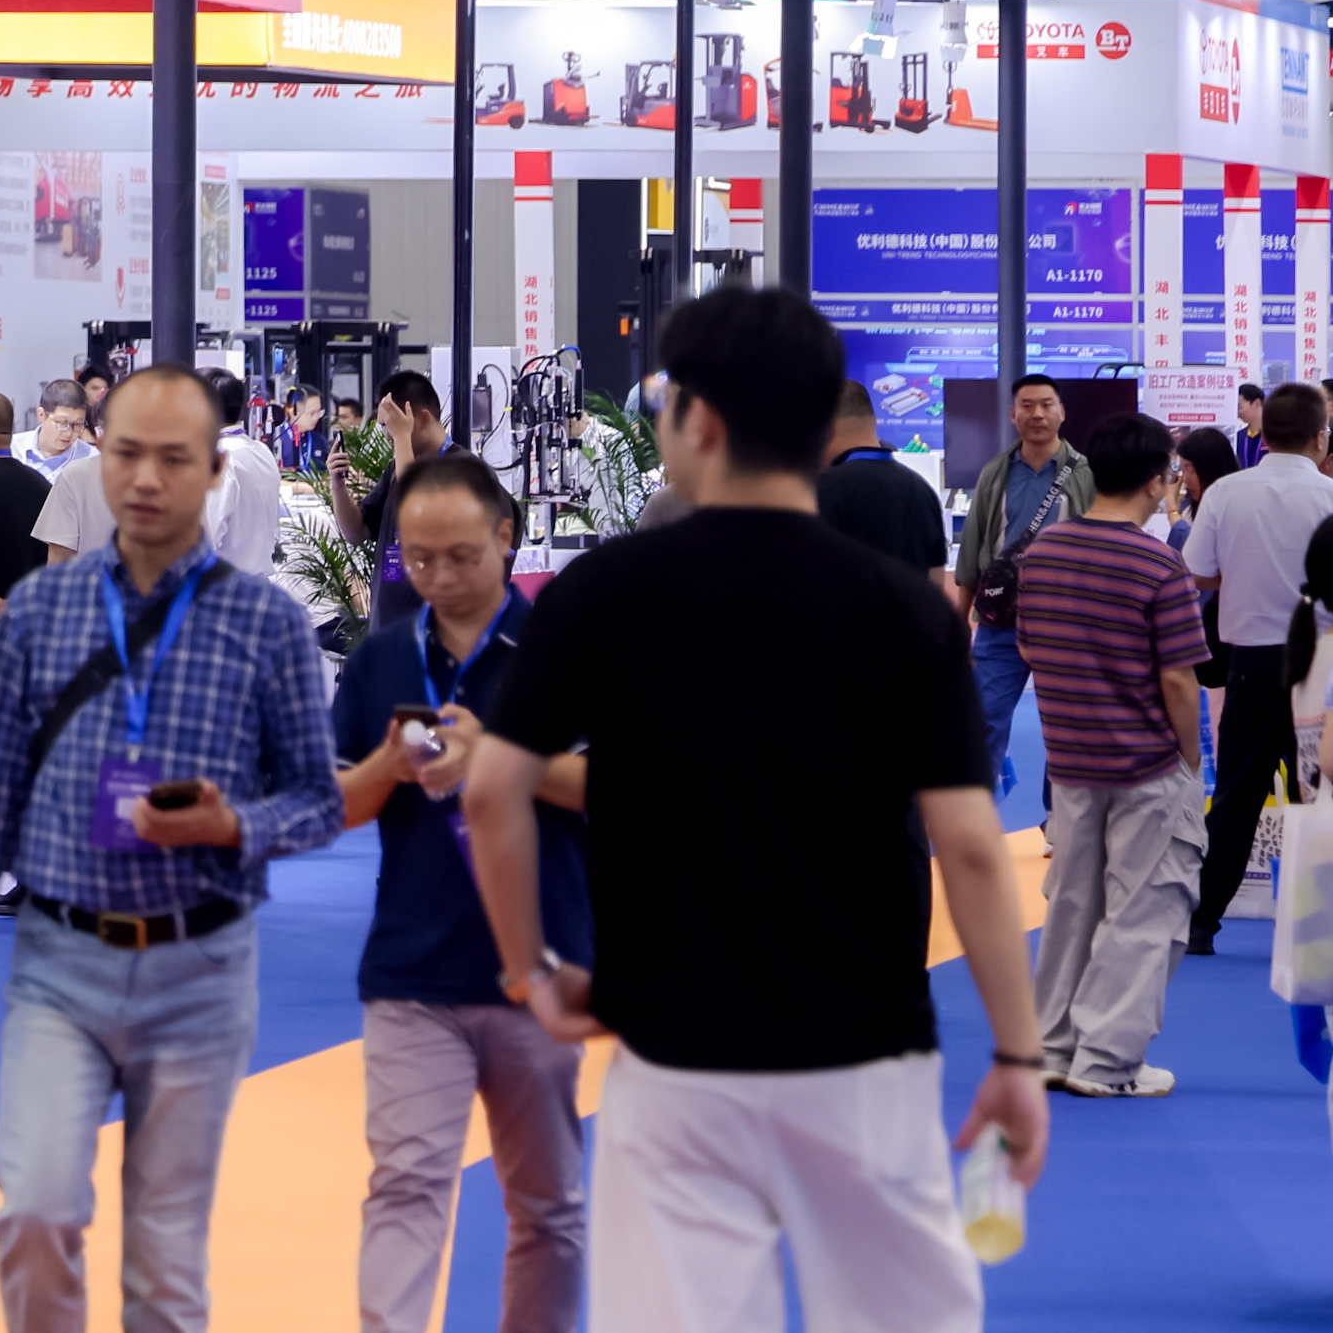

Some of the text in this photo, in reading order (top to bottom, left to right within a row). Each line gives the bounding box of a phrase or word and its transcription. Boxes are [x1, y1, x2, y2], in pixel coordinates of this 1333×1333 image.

[1026, 22, 1086, 40] OYOTA
[856, 233, 1057, 250] 优利德科技(中国)股份公司
[1046, 269, 1103, 283] A1-1170
[1053, 306, 1103, 318] A1-1170
